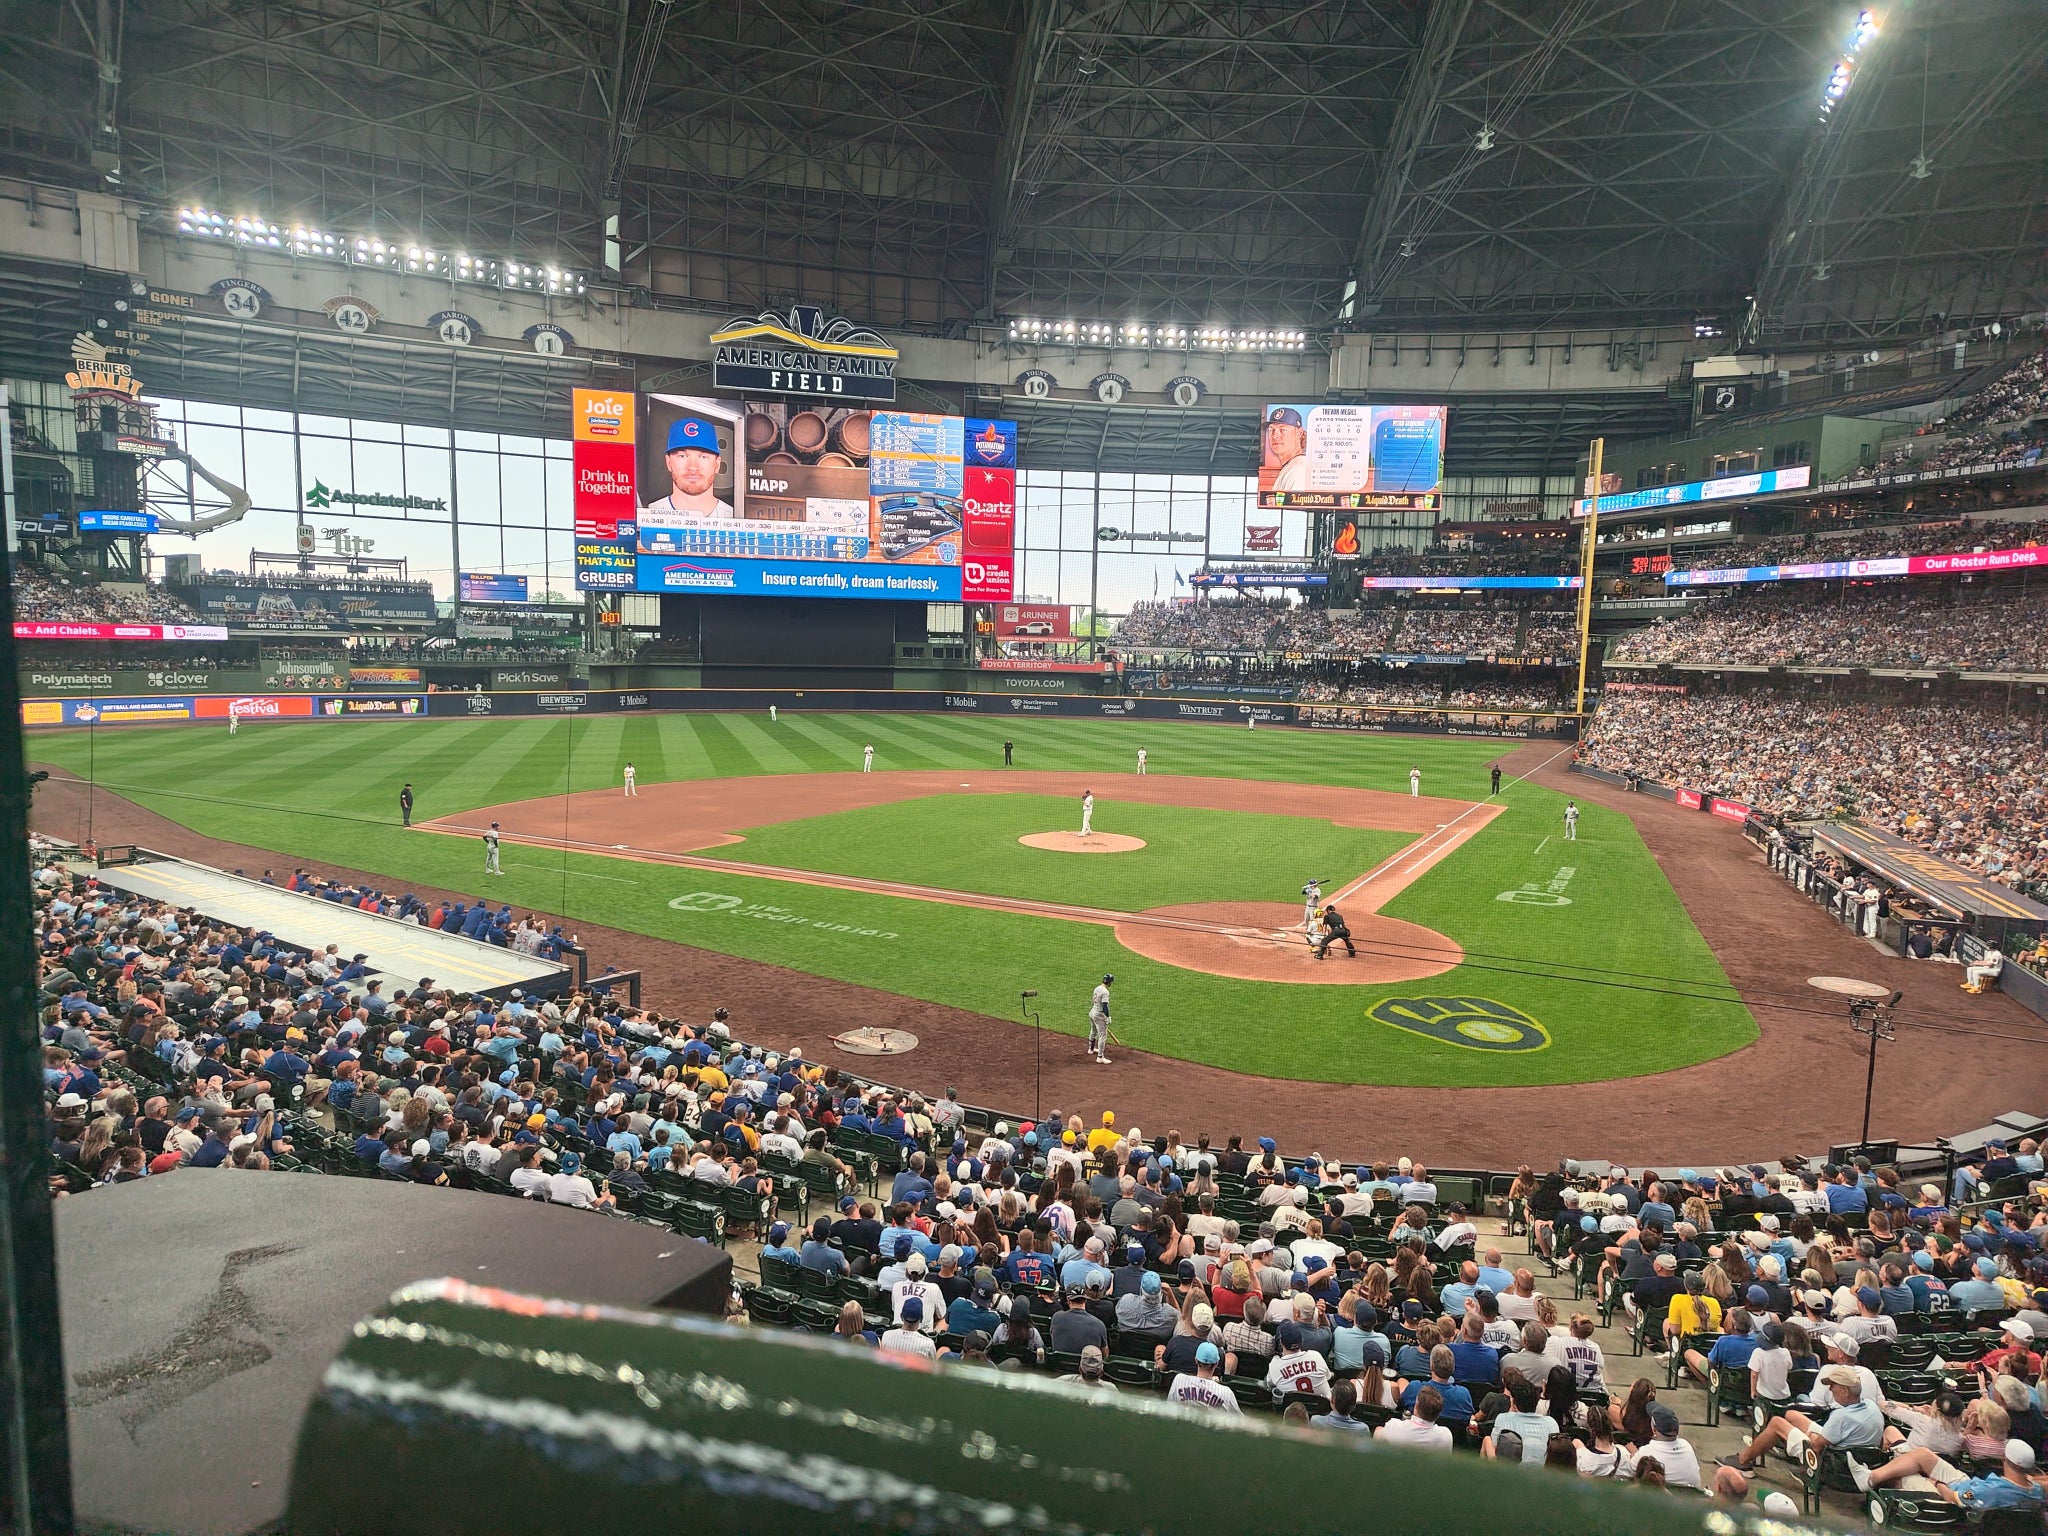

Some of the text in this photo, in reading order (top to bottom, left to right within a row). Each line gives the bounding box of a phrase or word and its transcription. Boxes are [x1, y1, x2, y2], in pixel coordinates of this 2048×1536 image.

[219, 279, 263, 293] FINGERS
[150, 291, 195, 309] GONE!
[227, 294, 255, 312] 34
[340, 309, 365, 328] 42
[441, 310, 470, 323] AARON
[115, 329, 135, 339] GET
[443, 325, 469, 342] 44
[537, 323, 561, 334] SELIG
[106, 345, 125, 355] GET
[545, 339, 554, 354] 1
[715, 347, 896, 378] AMERICAN FAMILY
[79, 361, 132, 378] BERNIE'S
[1026, 370, 1049, 379] YOUNT
[65, 371, 145, 397] CHALET
[770, 370, 844, 394] FIELD
[1096, 373, 1126, 385] MOLITOR
[1174, 376, 1199, 386] UECKER
[1028, 381, 1045, 395] 19
[1105, 385, 1115, 399] 4
[584, 398, 624, 416] Joie
[581, 469, 629, 484] Drink in
[749, 468, 763, 477] IAN
[577, 481, 633, 497] Together
[748, 478, 789, 494] HAPP
[964, 499, 1013, 517] Quartz
[1482, 498, 1545, 515] Johnsonville
[333, 534, 375, 556] Lite
[577, 545, 601, 556] ONE
[577, 555, 636, 568] THAT'S ALL!
[1925, 551, 2038, 570] Our Roster Runs Deep.
[578, 570, 634, 586] GRUBER
[664, 571, 734, 581] AMERICAN FAMILY
[985, 569, 1010, 578] credit
[762, 570, 940, 591] Insure carefully, dream fearlessly.
[985, 577, 1011, 585] union
[360, 608, 428, 619] TIME, MILWAUKEE
[1021, 611, 1060, 621] 4RUNNER
[35, 625, 56, 636] And
[58, 625, 101, 637] Chalets.
[304, 623, 330, 631] FILLING.
[516, 629, 540, 637] POWER
[1285, 651, 1302, 660] 620
[1303, 652, 1331, 661] WTMJ
[1424, 654, 1462, 664] WINTRUST
[1498, 657, 1541, 666] NICOLET LAW
[275, 661, 335, 675] Johnsonville
[983, 661, 1053, 670] TOYOTA TERRITORY
[31, 673, 113, 687] Polymatech
[164, 670, 209, 685] clover
[350, 670, 391, 684] Surfside
[531, 672, 559, 684] Save
[1004, 678, 1066, 690] TOYOTA.COM
[227, 699, 280, 716] festival
[466, 697, 492, 710] TRUSS
[626, 695, 648, 707] Mobile
[952, 697, 978, 708] Mobile
[1022, 699, 1059, 708] Northwestern
[1101, 702, 1123, 711] Johnson
[1022, 704, 1043, 712] Mutual
[1103, 707, 1126, 716] Controls
[1178, 704, 1226, 716] WINTRUST
[1251, 706, 1272, 715] Aurora
[1271, 714, 1285, 722] Care
[1501, 731, 1528, 739] BULLPEN
[746, 903, 790, 914] uw
[812, 920, 900, 940] union
[935, 1109, 953, 1123] 17
[1016, 1258, 1042, 1269] BRYANT
[1929, 1293, 1951, 1313] 22
[1566, 1347, 1598, 1363] BRYANT
[1279, 1360, 1318, 1380] UECKER
